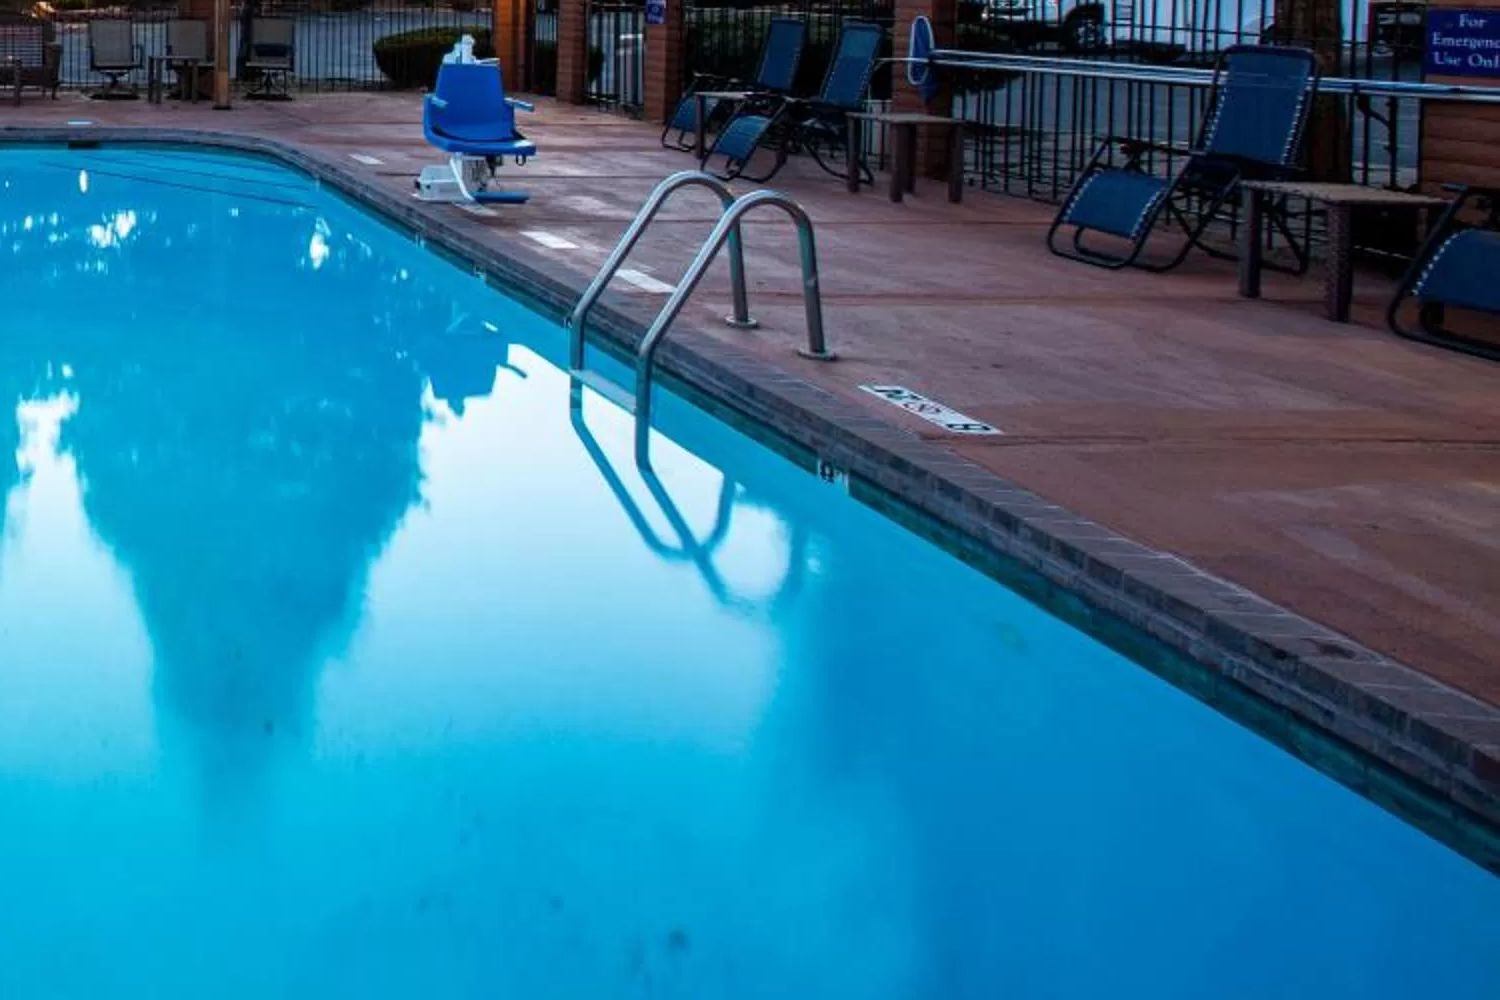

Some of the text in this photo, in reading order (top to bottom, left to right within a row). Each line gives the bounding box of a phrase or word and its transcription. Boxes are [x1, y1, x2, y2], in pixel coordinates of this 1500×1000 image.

[1459, 13, 1488, 29] For
[1432, 31, 1500, 51] Emergenc
[1431, 51, 1500, 69] Use Onl
